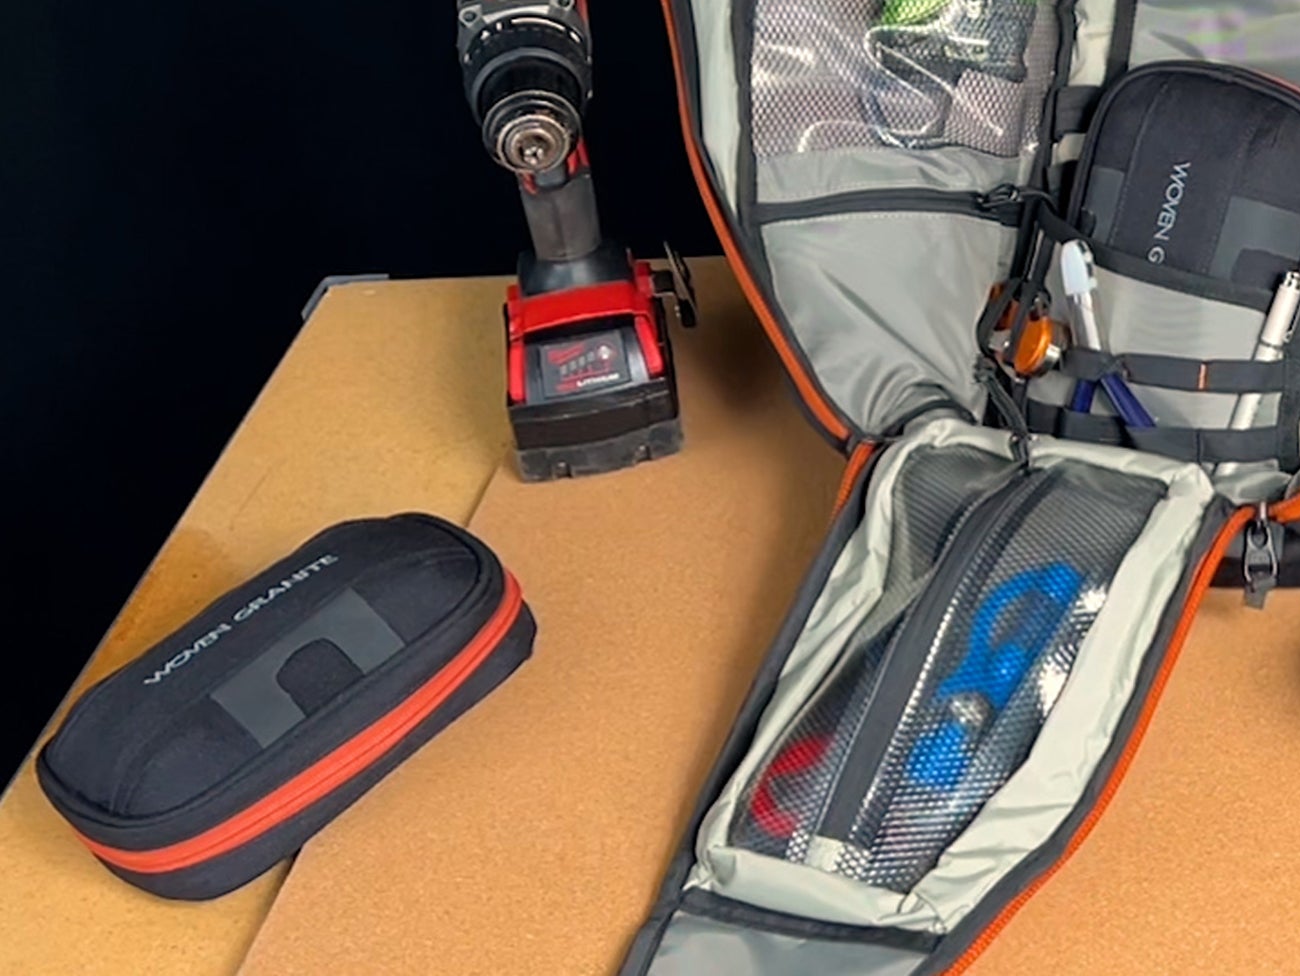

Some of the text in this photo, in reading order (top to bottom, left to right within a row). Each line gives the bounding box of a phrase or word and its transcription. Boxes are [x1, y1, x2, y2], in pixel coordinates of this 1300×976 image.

[1153, 162, 1191, 241] WOVEN
[143, 554, 339, 685] WOVEN GRANITE
